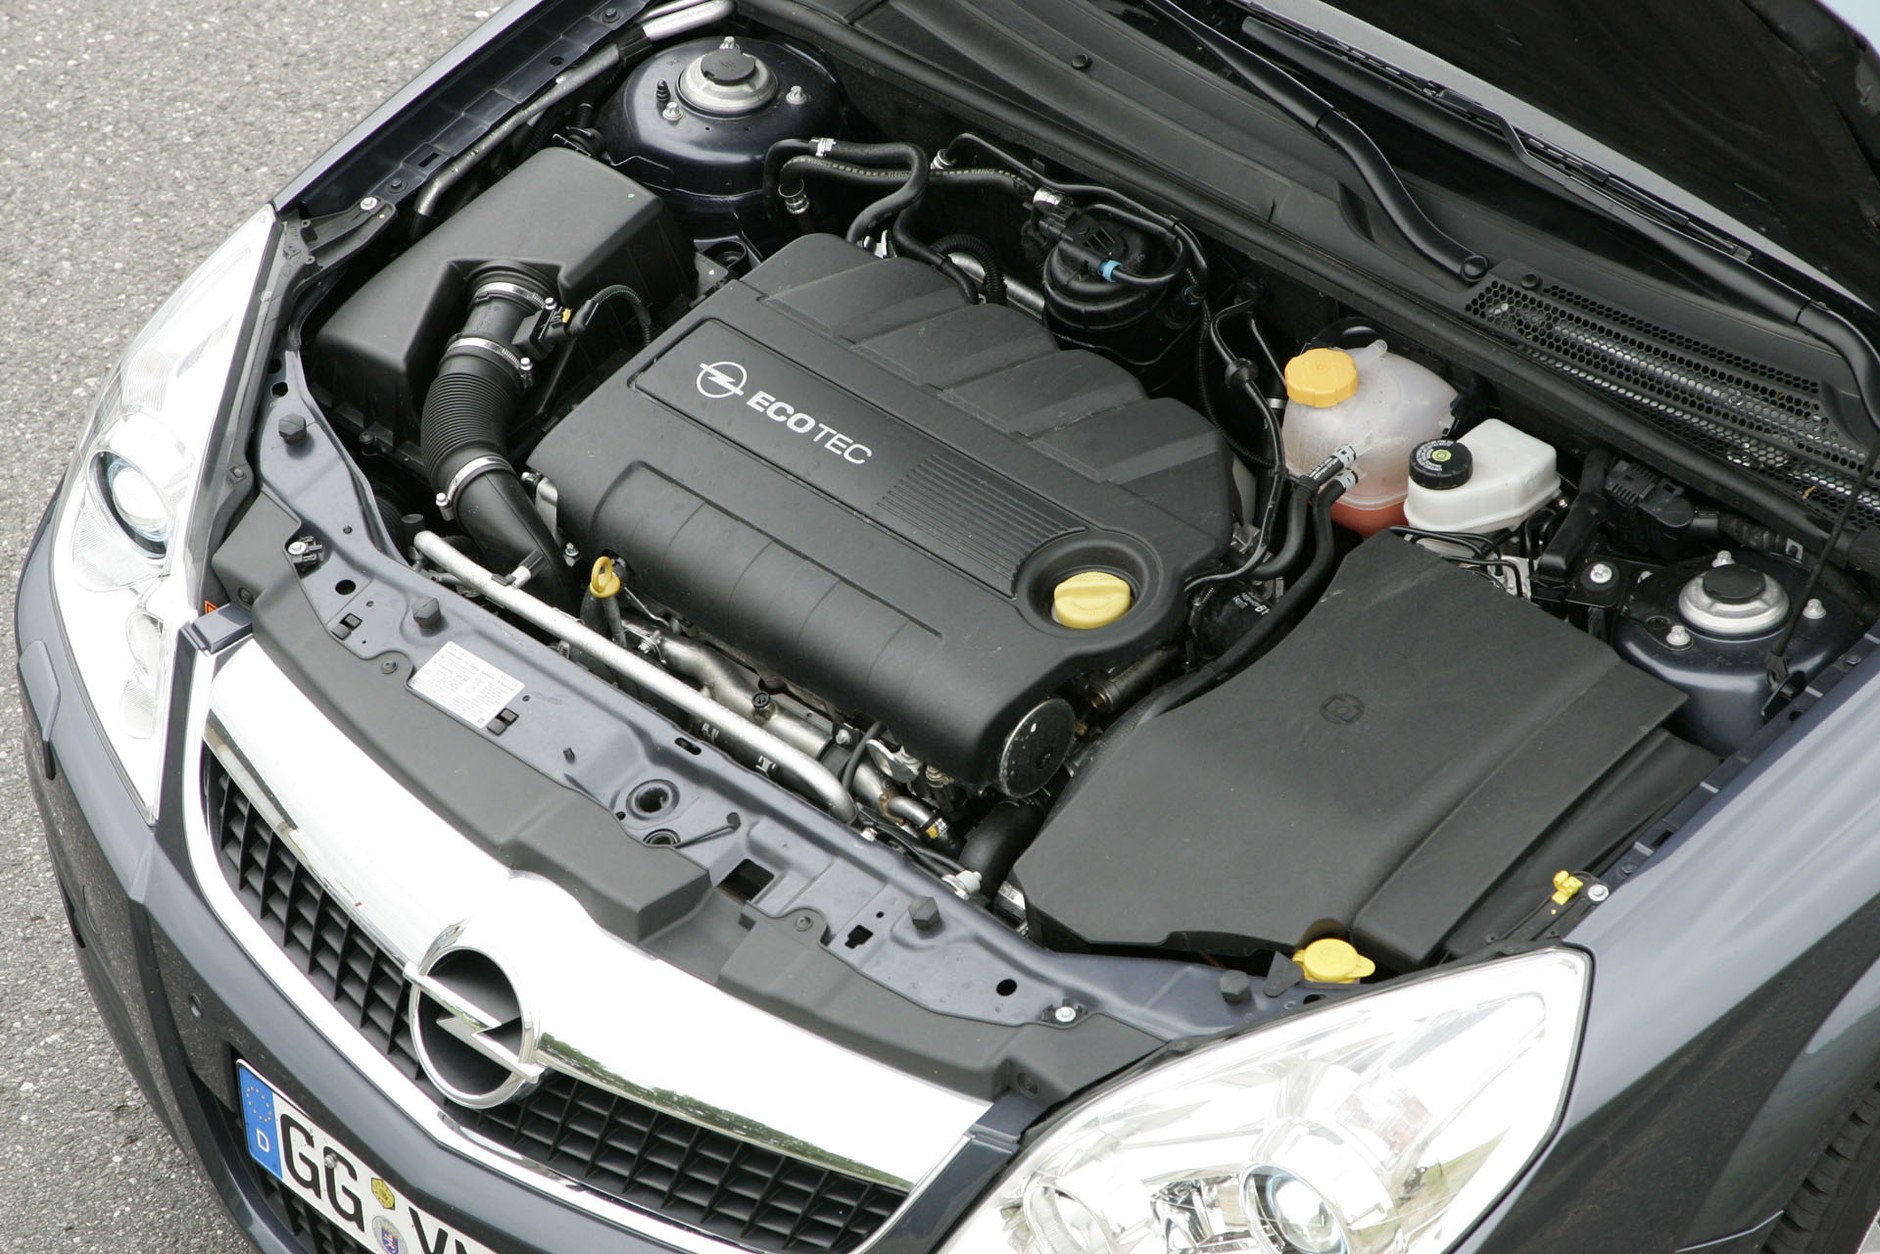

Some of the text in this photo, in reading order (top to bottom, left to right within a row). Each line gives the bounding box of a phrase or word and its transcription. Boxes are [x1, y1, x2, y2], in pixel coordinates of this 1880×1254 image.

[746, 391, 872, 465] ECOTEC
[256, 1128, 271, 1152] D
[280, 1113, 366, 1233] GG
